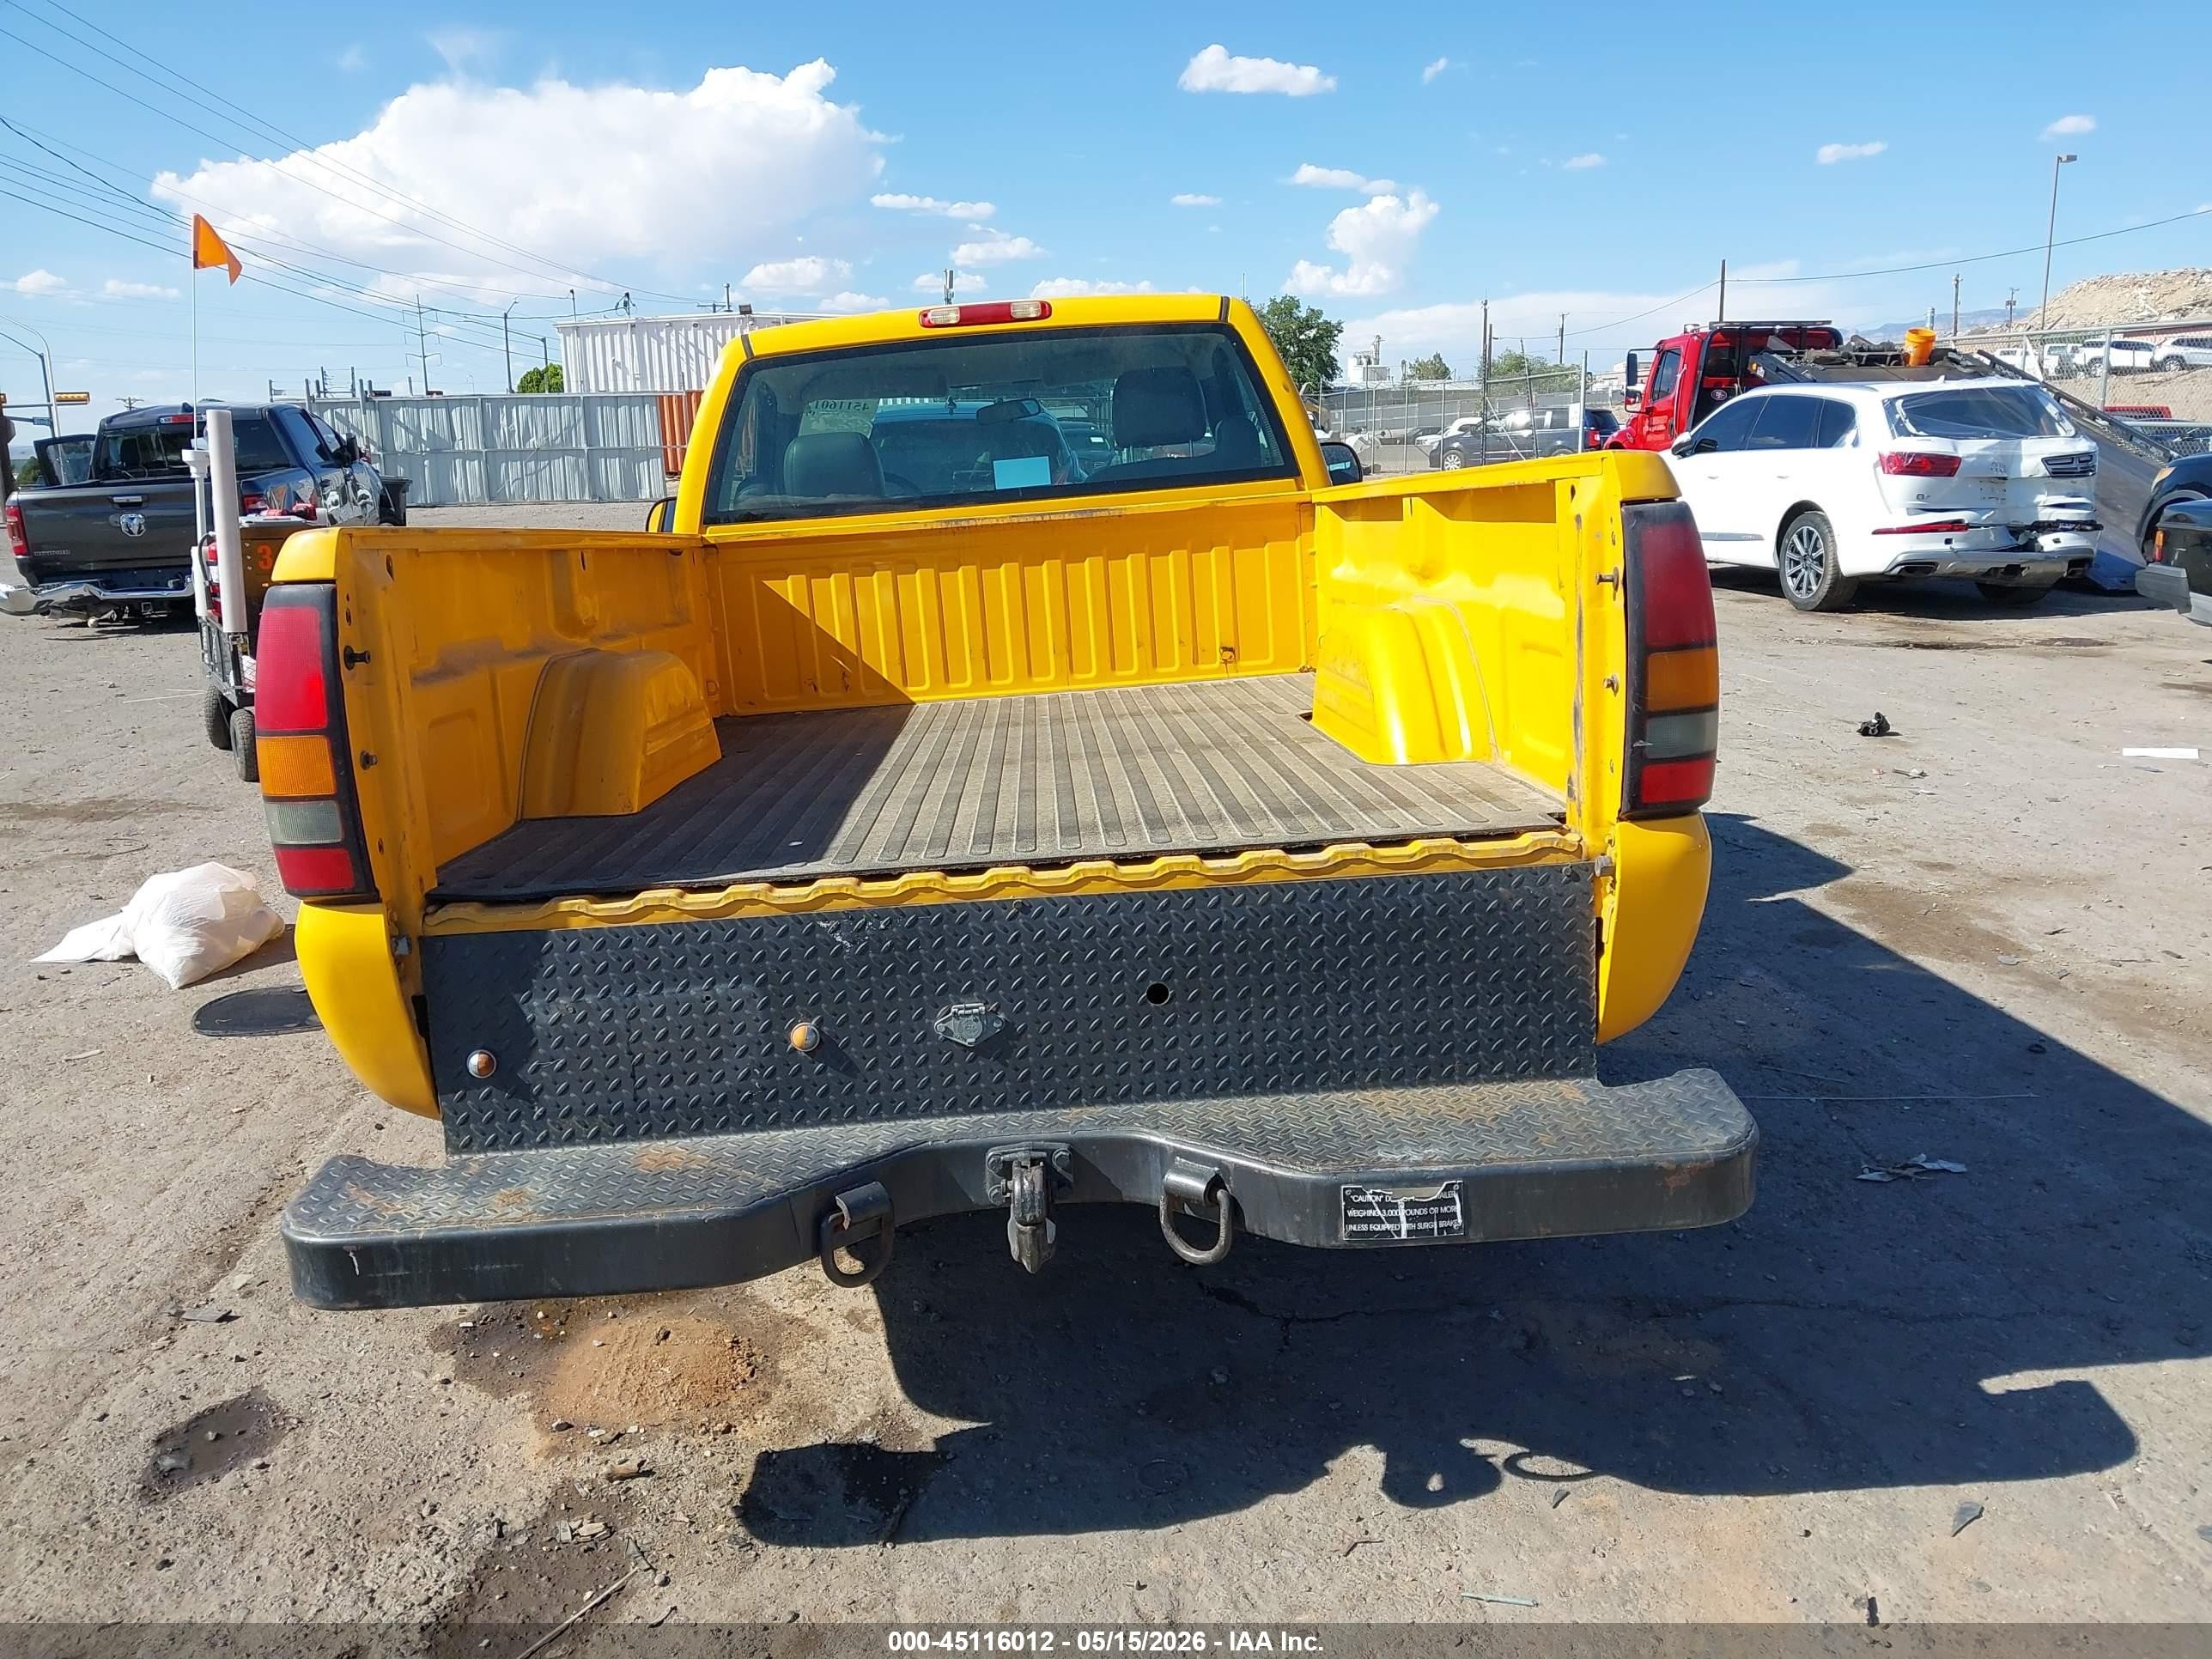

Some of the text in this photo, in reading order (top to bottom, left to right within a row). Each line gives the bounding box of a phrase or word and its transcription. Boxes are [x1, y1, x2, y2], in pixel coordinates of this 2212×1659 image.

[258, 545, 273, 569] 3
[1346, 1208, 1381, 1217] WEIGHING
[1346, 1223, 1369, 1231] UNLESS
[1370, 1223, 1401, 1231] EQUIPPED
[1401, 1222, 1416, 1231] ITH
